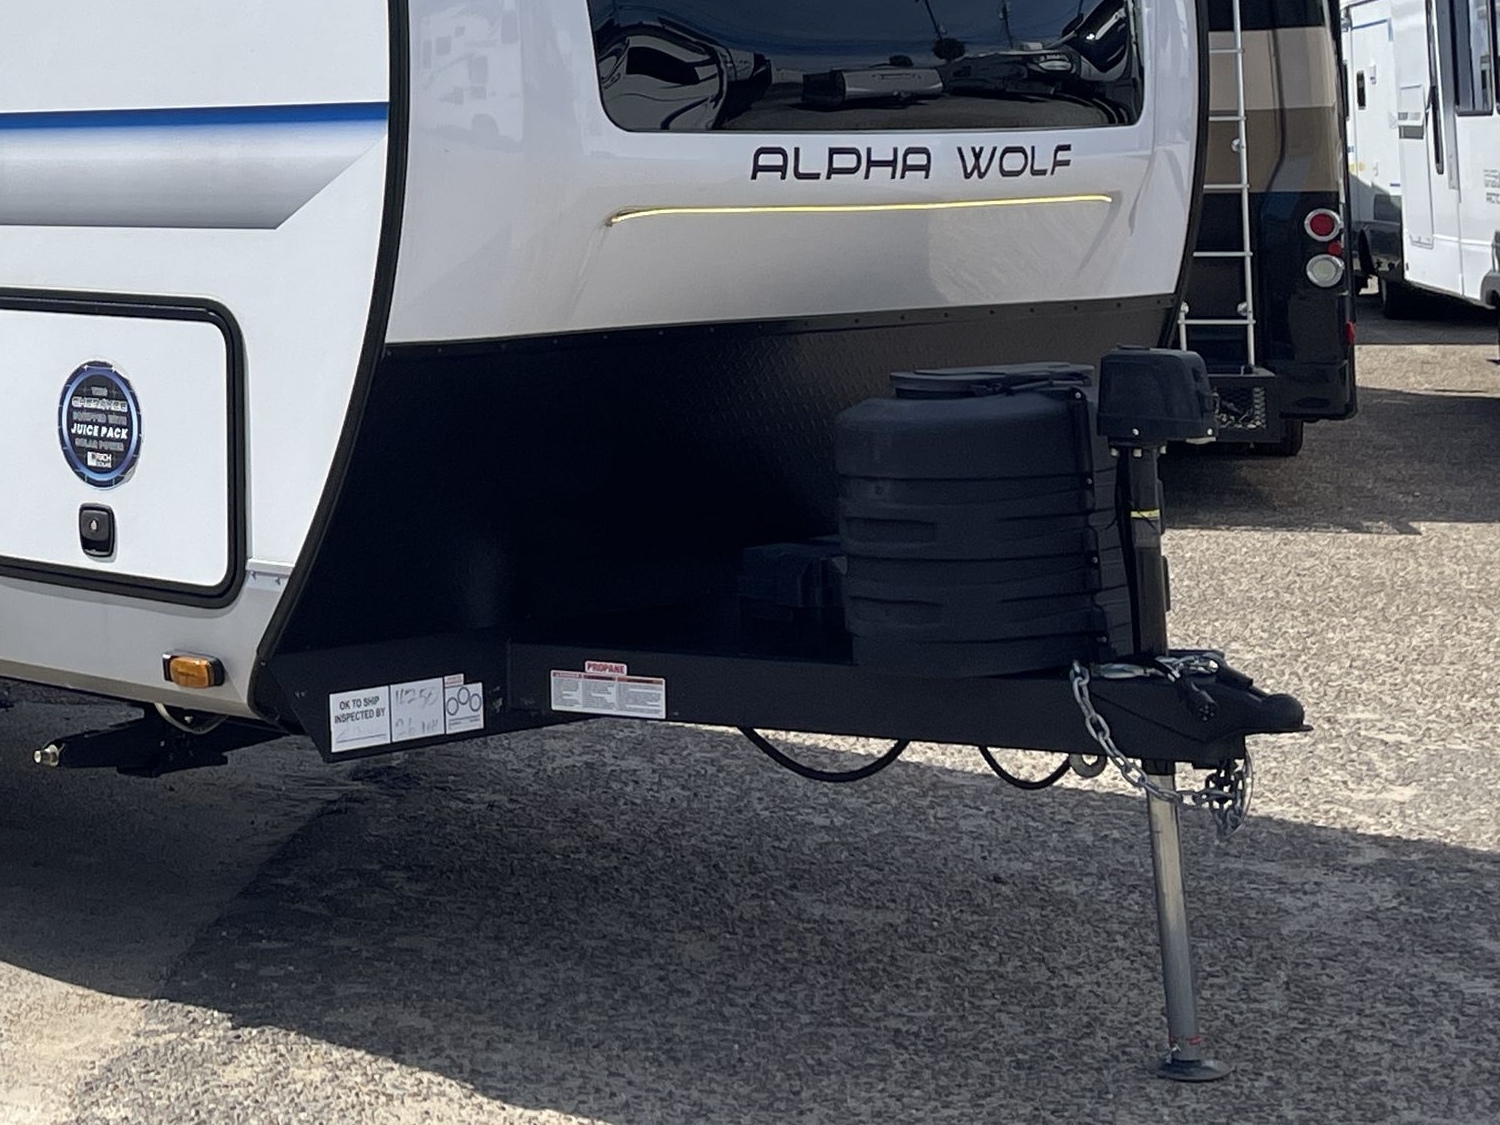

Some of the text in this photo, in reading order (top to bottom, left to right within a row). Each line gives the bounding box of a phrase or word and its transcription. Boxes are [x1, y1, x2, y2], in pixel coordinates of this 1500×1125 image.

[750, 143, 1072, 180] ALPHA WOLF
[70, 423, 129, 440] JUICE PACK
[587, 662, 626, 674] PROPANE
[339, 696, 380, 711] OK TO SHIP
[334, 707, 386, 724] INSPECTED BY
